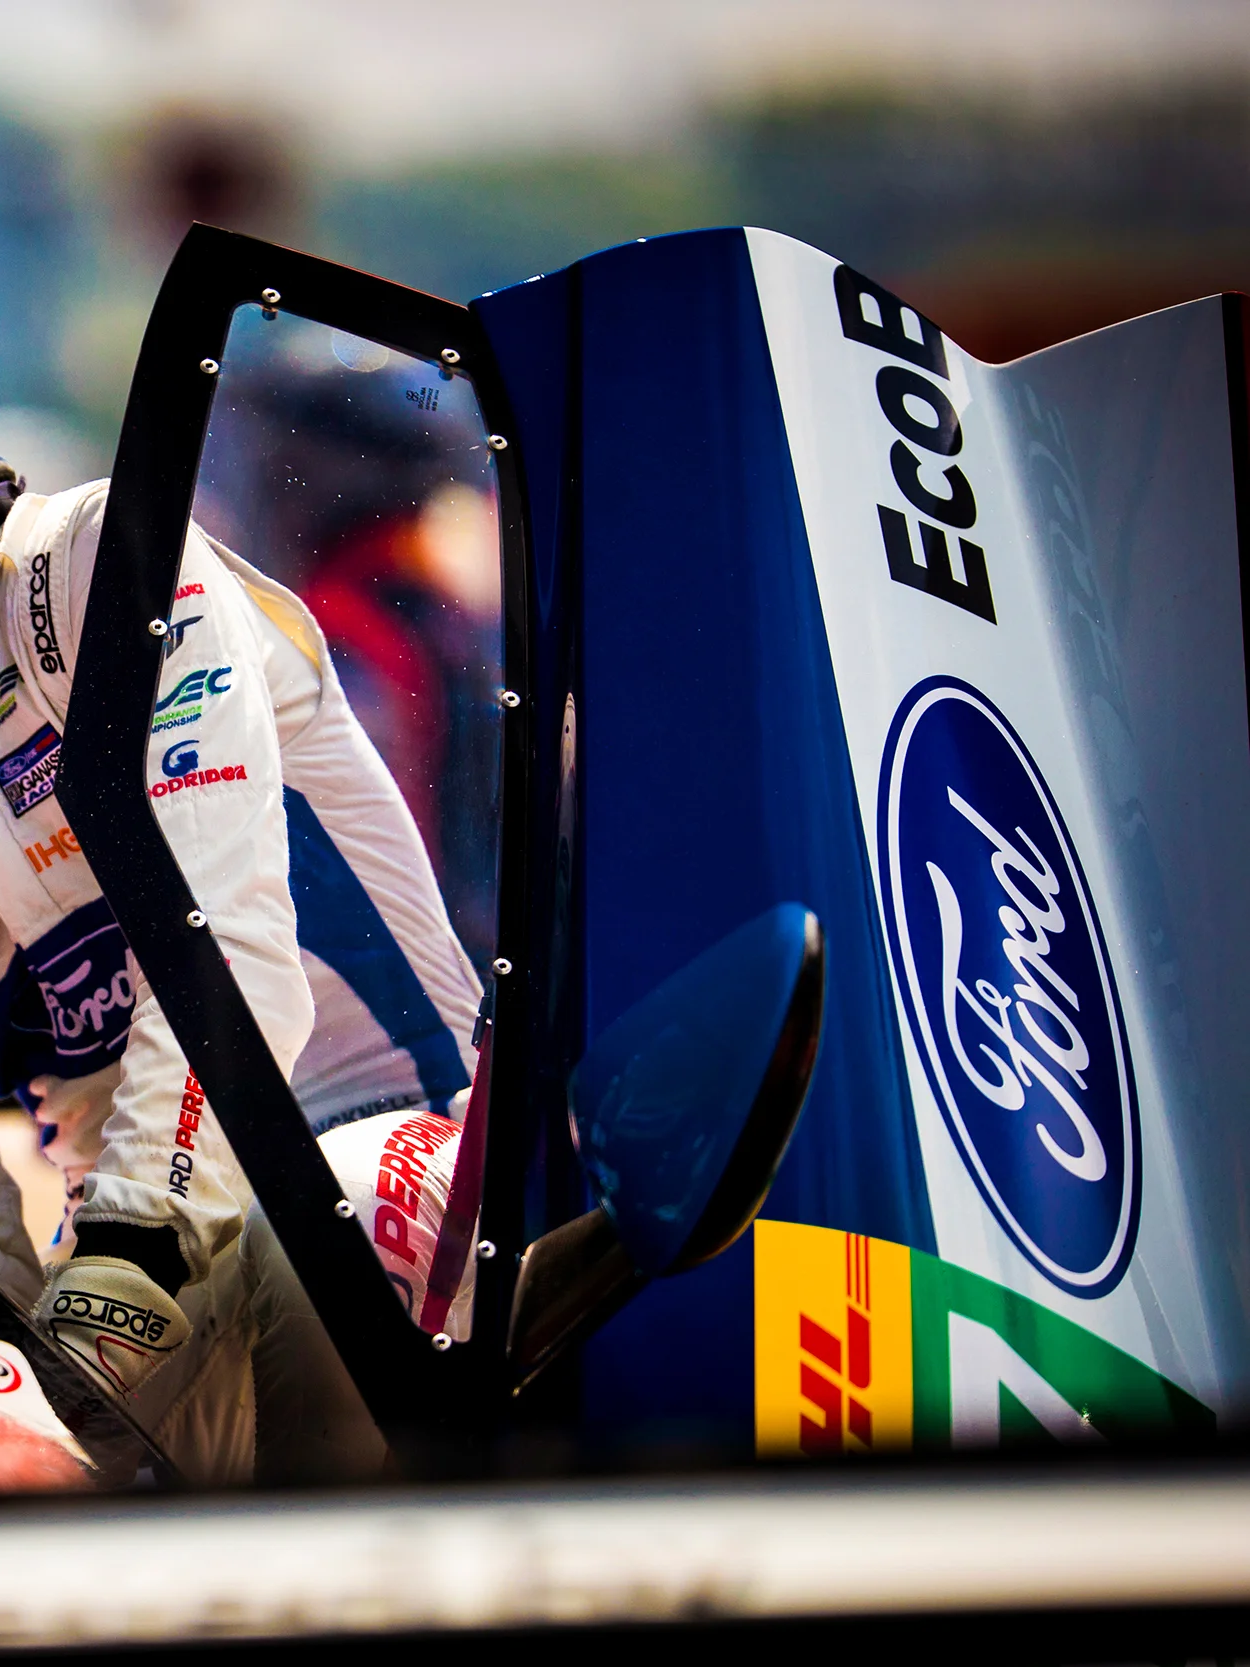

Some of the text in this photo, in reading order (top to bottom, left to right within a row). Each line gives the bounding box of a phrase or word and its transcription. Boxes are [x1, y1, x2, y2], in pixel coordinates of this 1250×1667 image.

[29, 552, 64, 674] sparco
[924, 785, 1108, 1183] Ford
[52, 1290, 169, 1343] sparco
